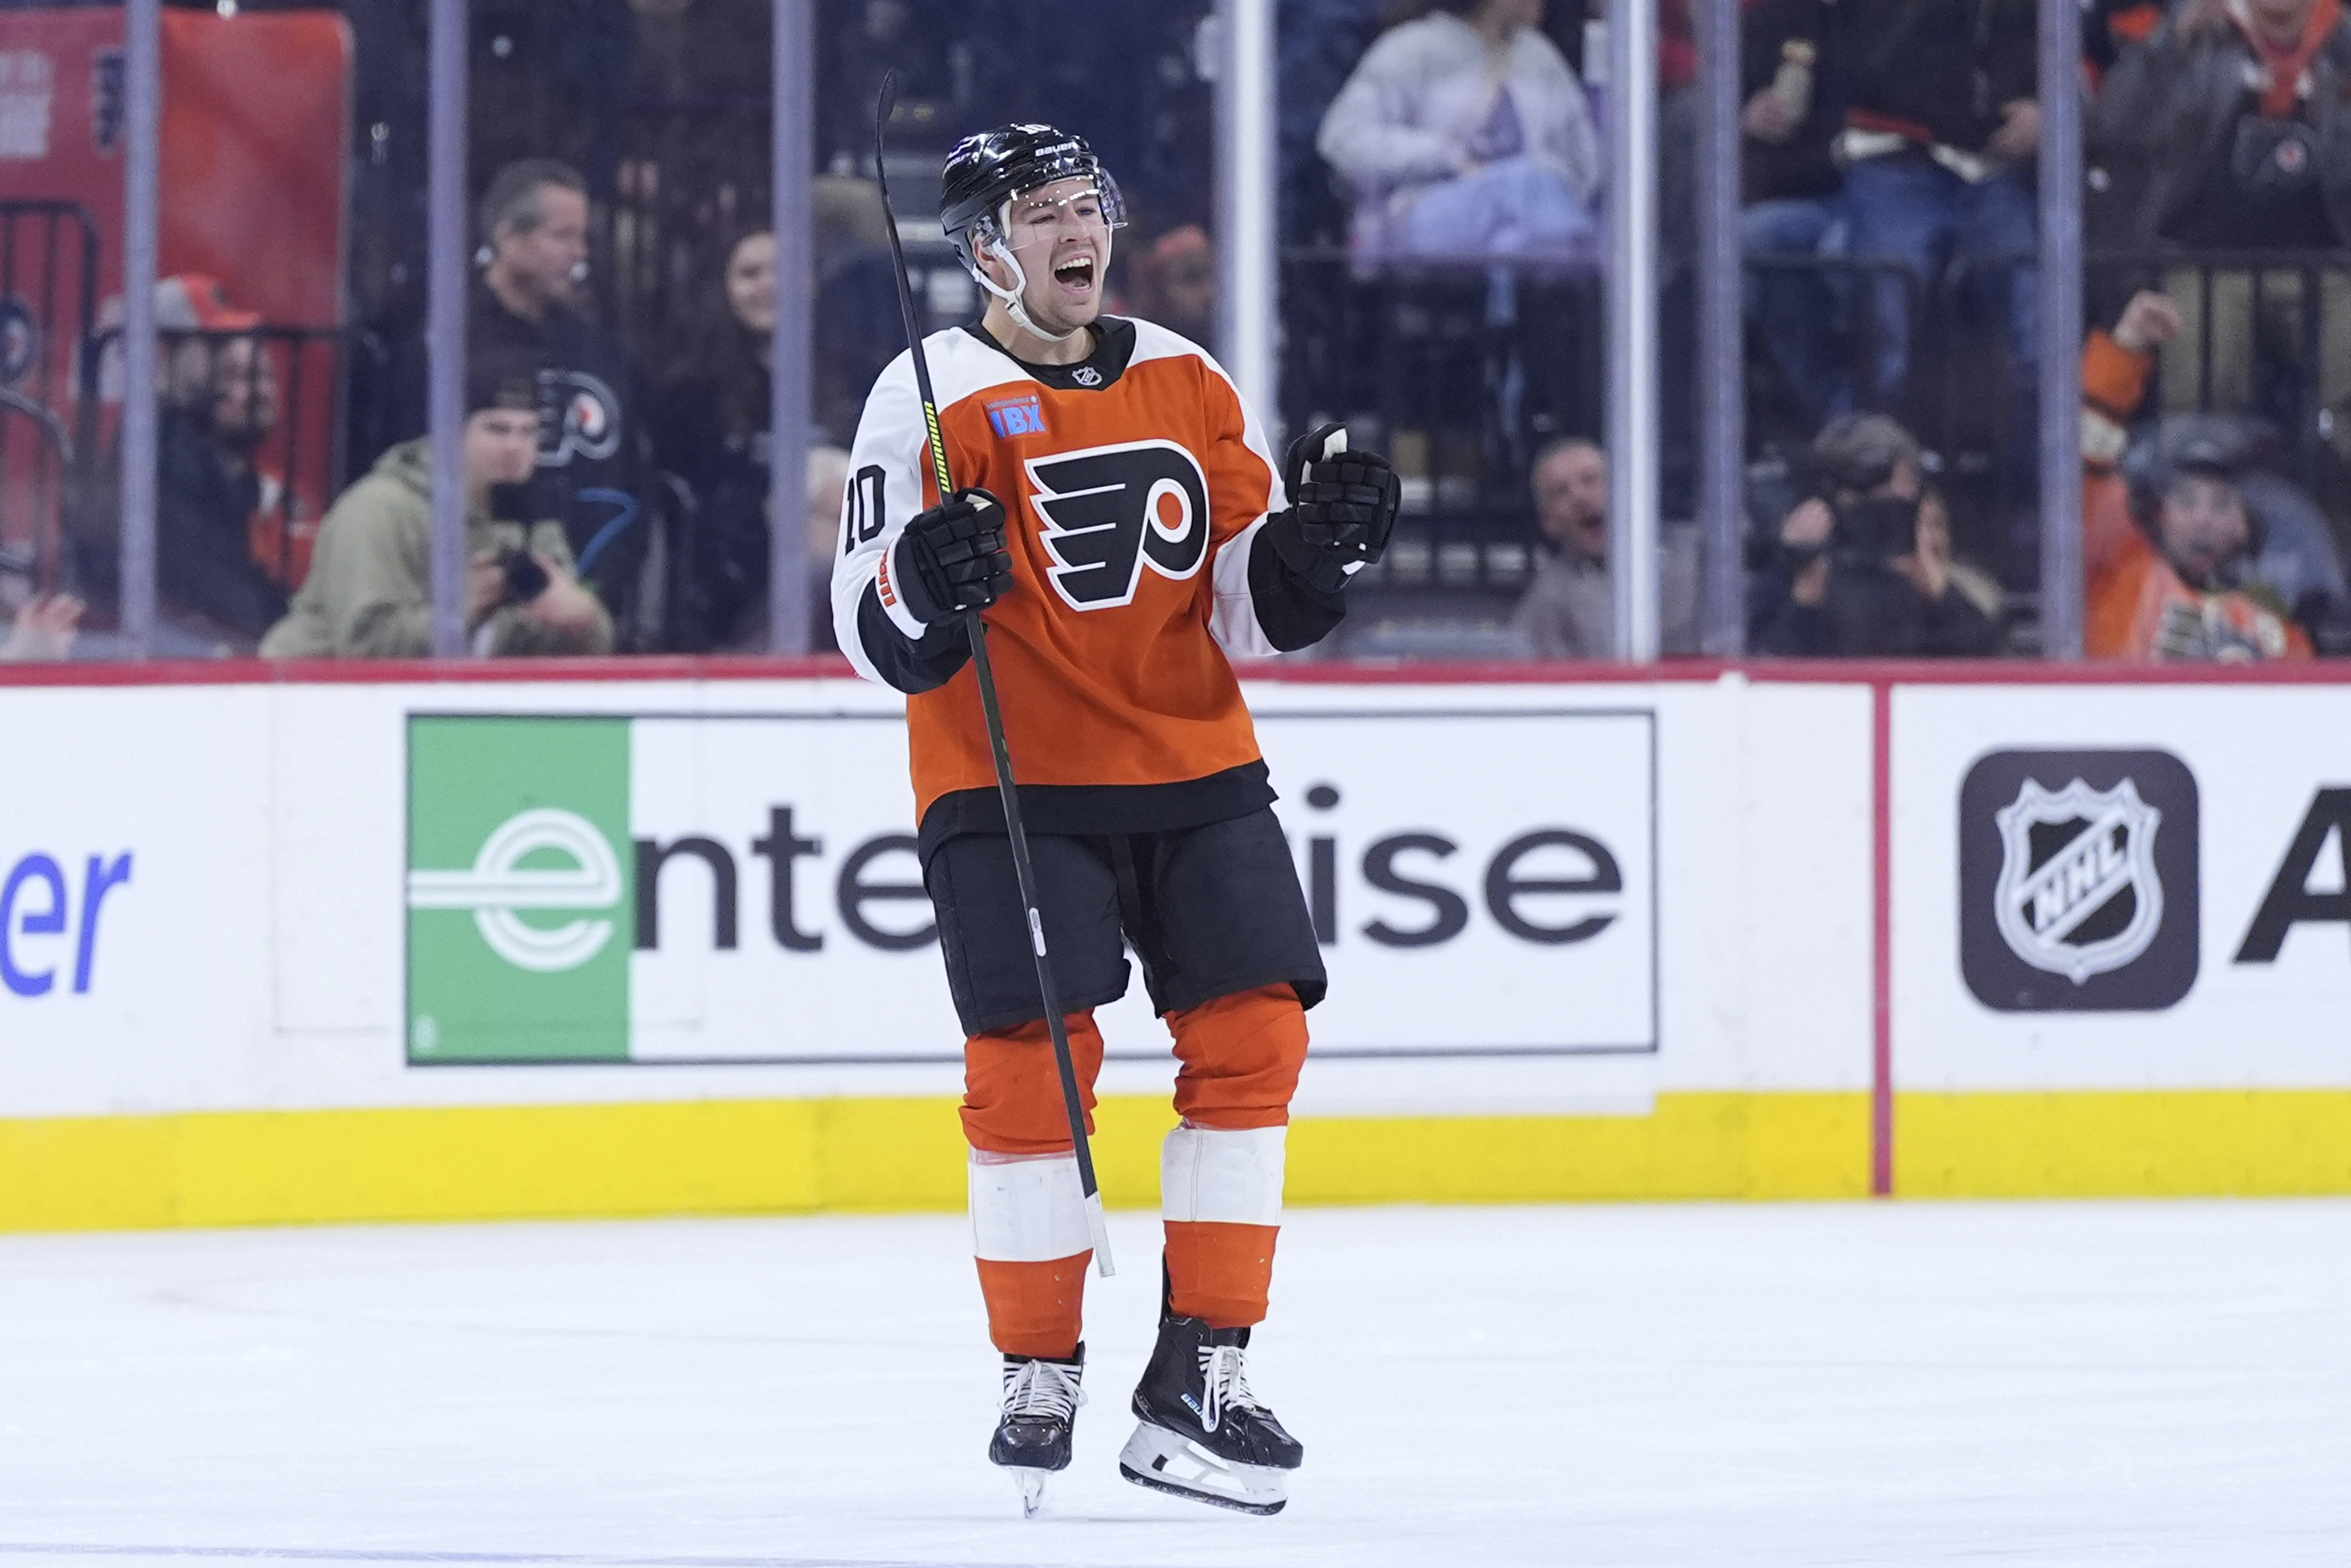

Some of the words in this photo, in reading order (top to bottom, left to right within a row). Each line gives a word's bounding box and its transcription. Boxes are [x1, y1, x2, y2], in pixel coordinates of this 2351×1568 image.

[924, 400, 952, 494] WARRIOR
[990, 403, 1047, 438] IBX
[844, 464, 886, 558] 10
[408, 784, 1623, 972] enteise
[2033, 824, 2131, 934] NHL
